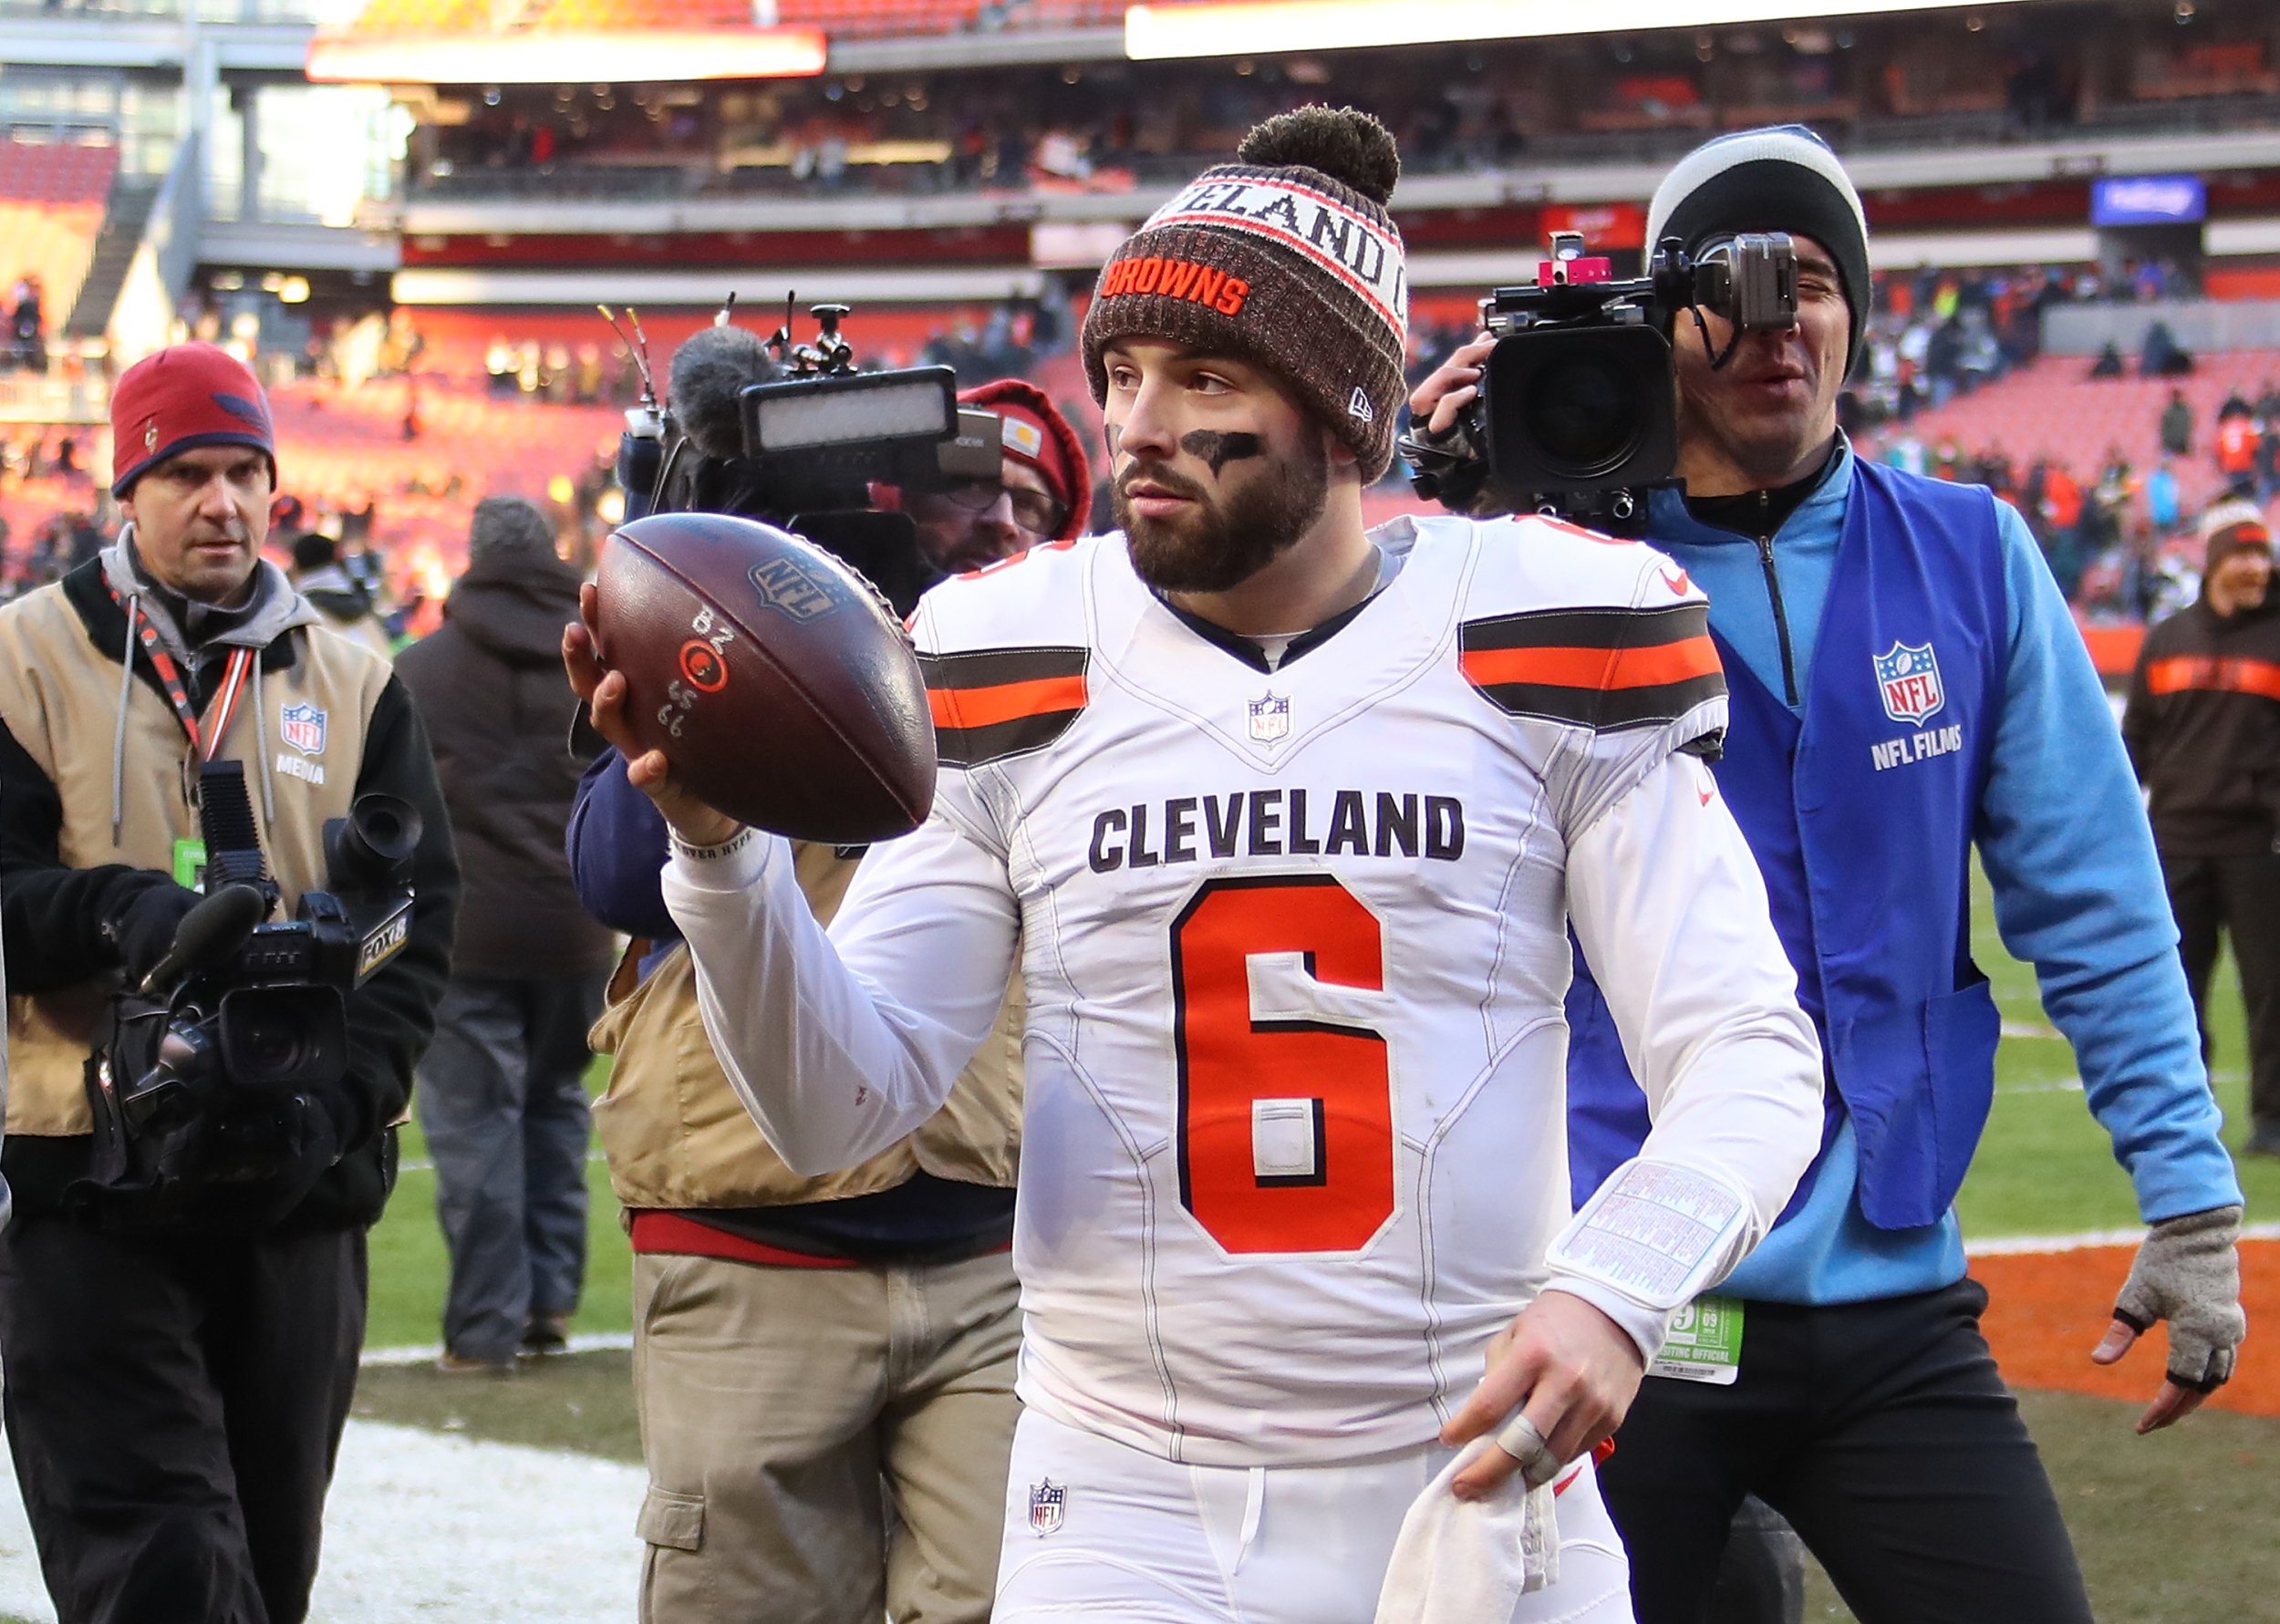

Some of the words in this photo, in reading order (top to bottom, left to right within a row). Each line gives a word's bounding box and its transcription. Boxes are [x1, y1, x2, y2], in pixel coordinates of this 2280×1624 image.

[1176, 182, 1385, 286] ELAND
[1101, 254, 1250, 316] BROWNS
[758, 560, 826, 617] NFL
[1885, 675, 1938, 713] NFL
[286, 721, 321, 748] NFL
[1254, 715, 1286, 739] NFL
[1871, 738, 1914, 771] NFL
[1912, 724, 1962, 760] FILMS
[276, 753, 325, 785] MEDIA
[1089, 788, 1465, 873] CLEVELAND
[363, 922, 396, 967] FOX
[1168, 873, 1397, 1257] 6
[1692, 1349, 1730, 1362] OFFICIAL
[1034, 1505, 1057, 1529] NFL
